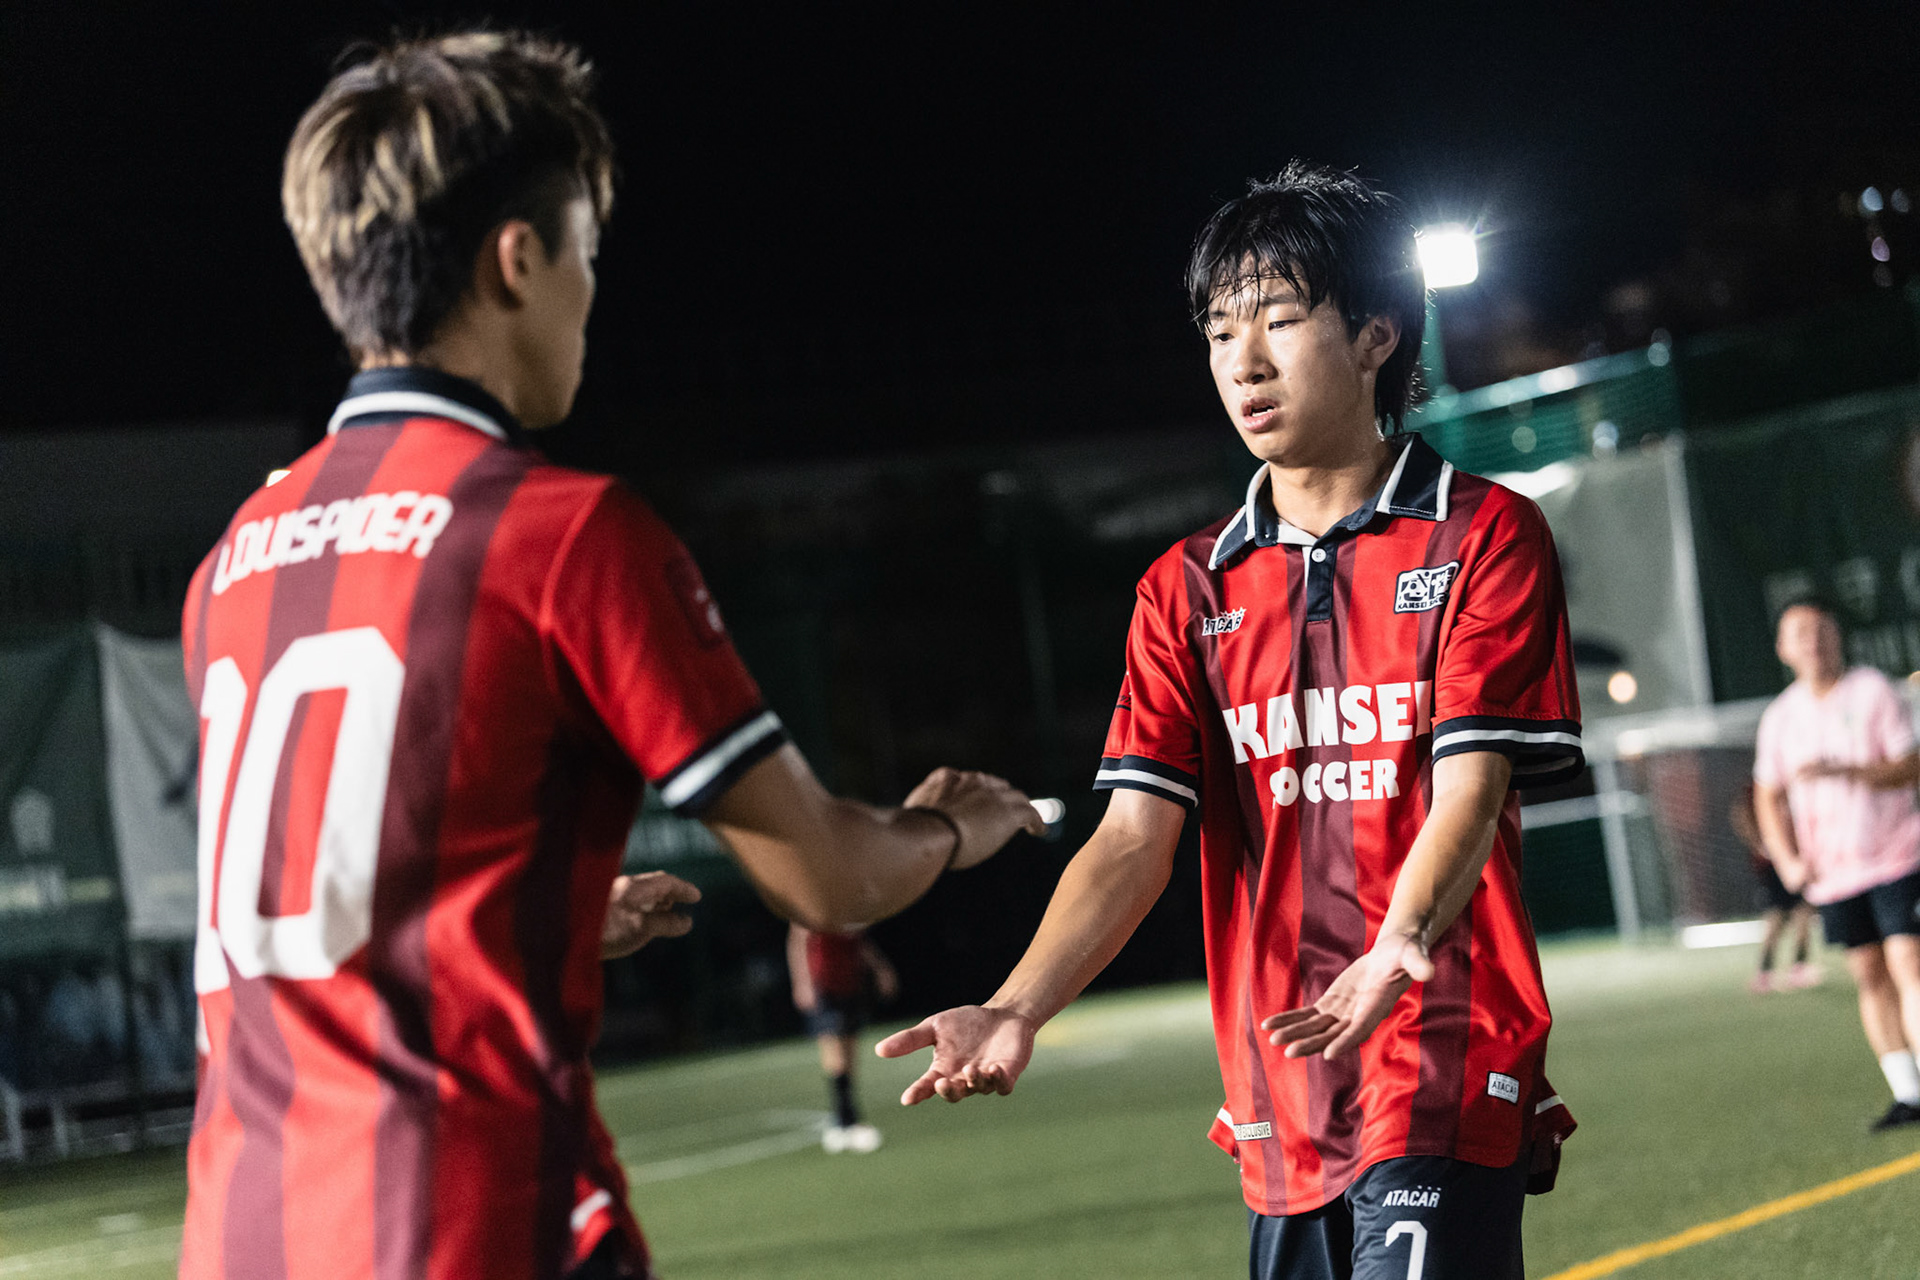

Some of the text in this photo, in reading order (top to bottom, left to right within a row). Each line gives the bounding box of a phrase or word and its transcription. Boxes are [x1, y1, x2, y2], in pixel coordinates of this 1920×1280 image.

[194, 625, 406, 993] 10
[1269, 758, 1400, 809] OCCER
[1382, 1189, 1440, 1209] ATACAR
